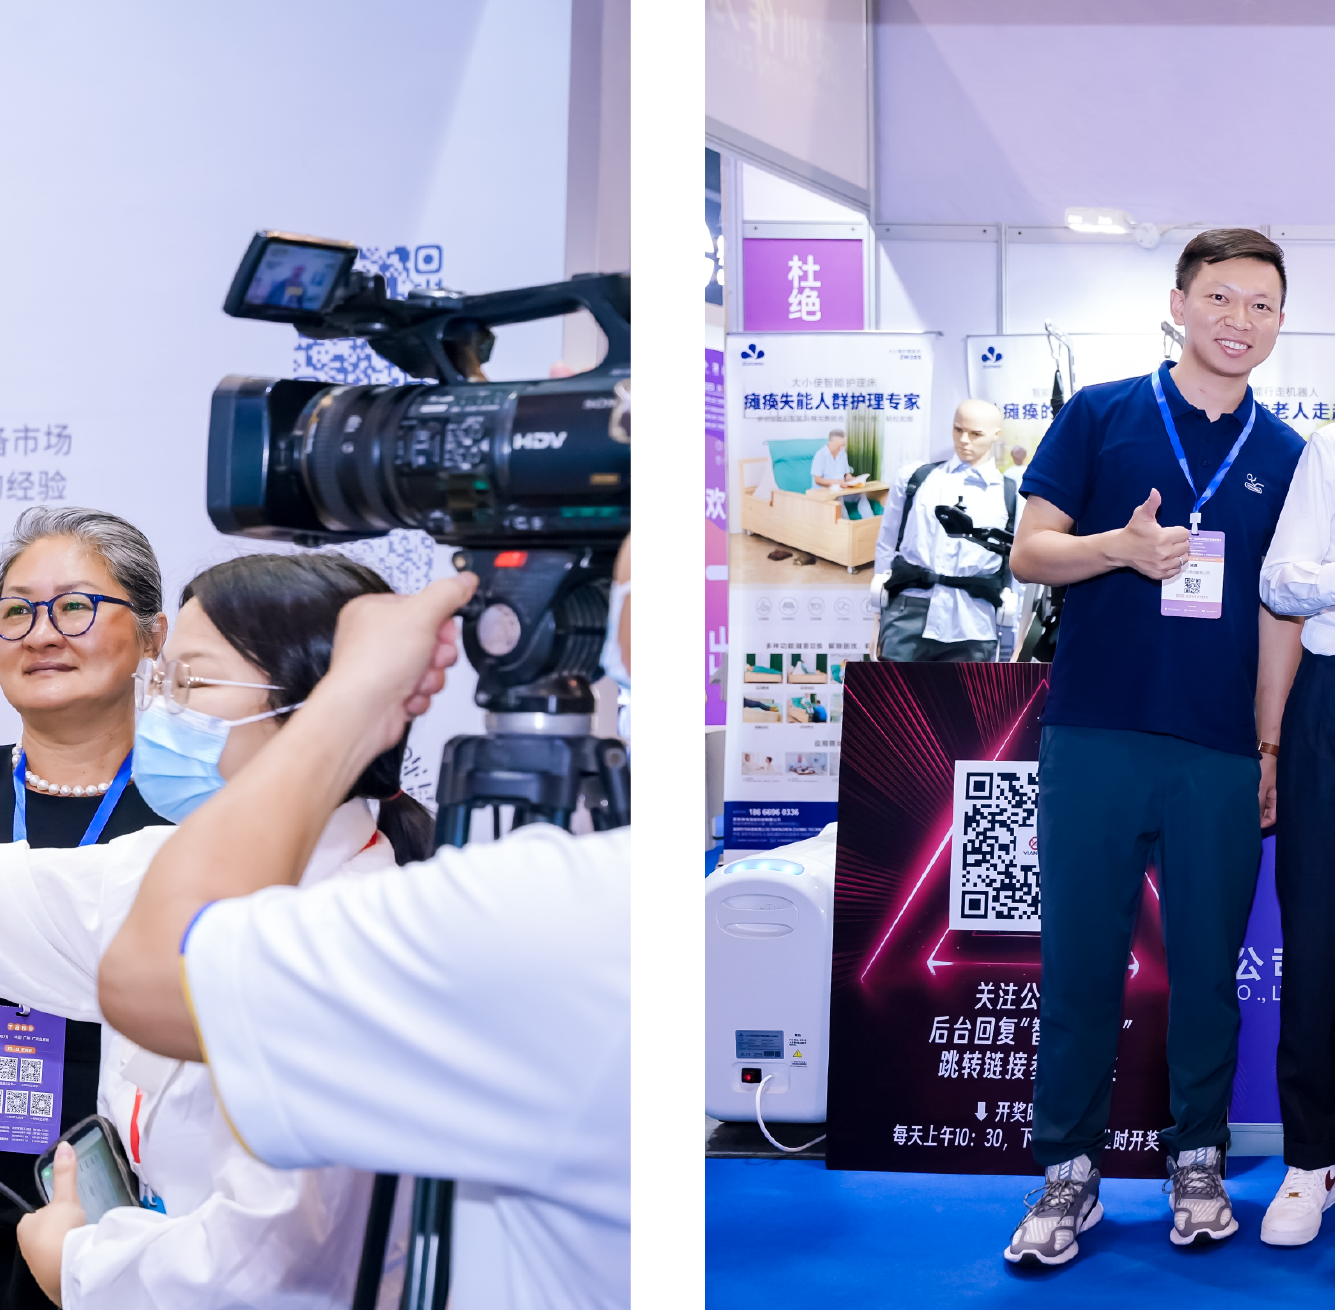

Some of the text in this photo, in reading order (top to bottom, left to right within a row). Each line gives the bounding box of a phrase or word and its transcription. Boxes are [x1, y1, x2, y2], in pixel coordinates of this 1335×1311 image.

[787, 254, 822, 322] 杜绝
[744, 392, 921, 411] 瘫痪失能人群护理专家
[513, 432, 567, 449] HDV
